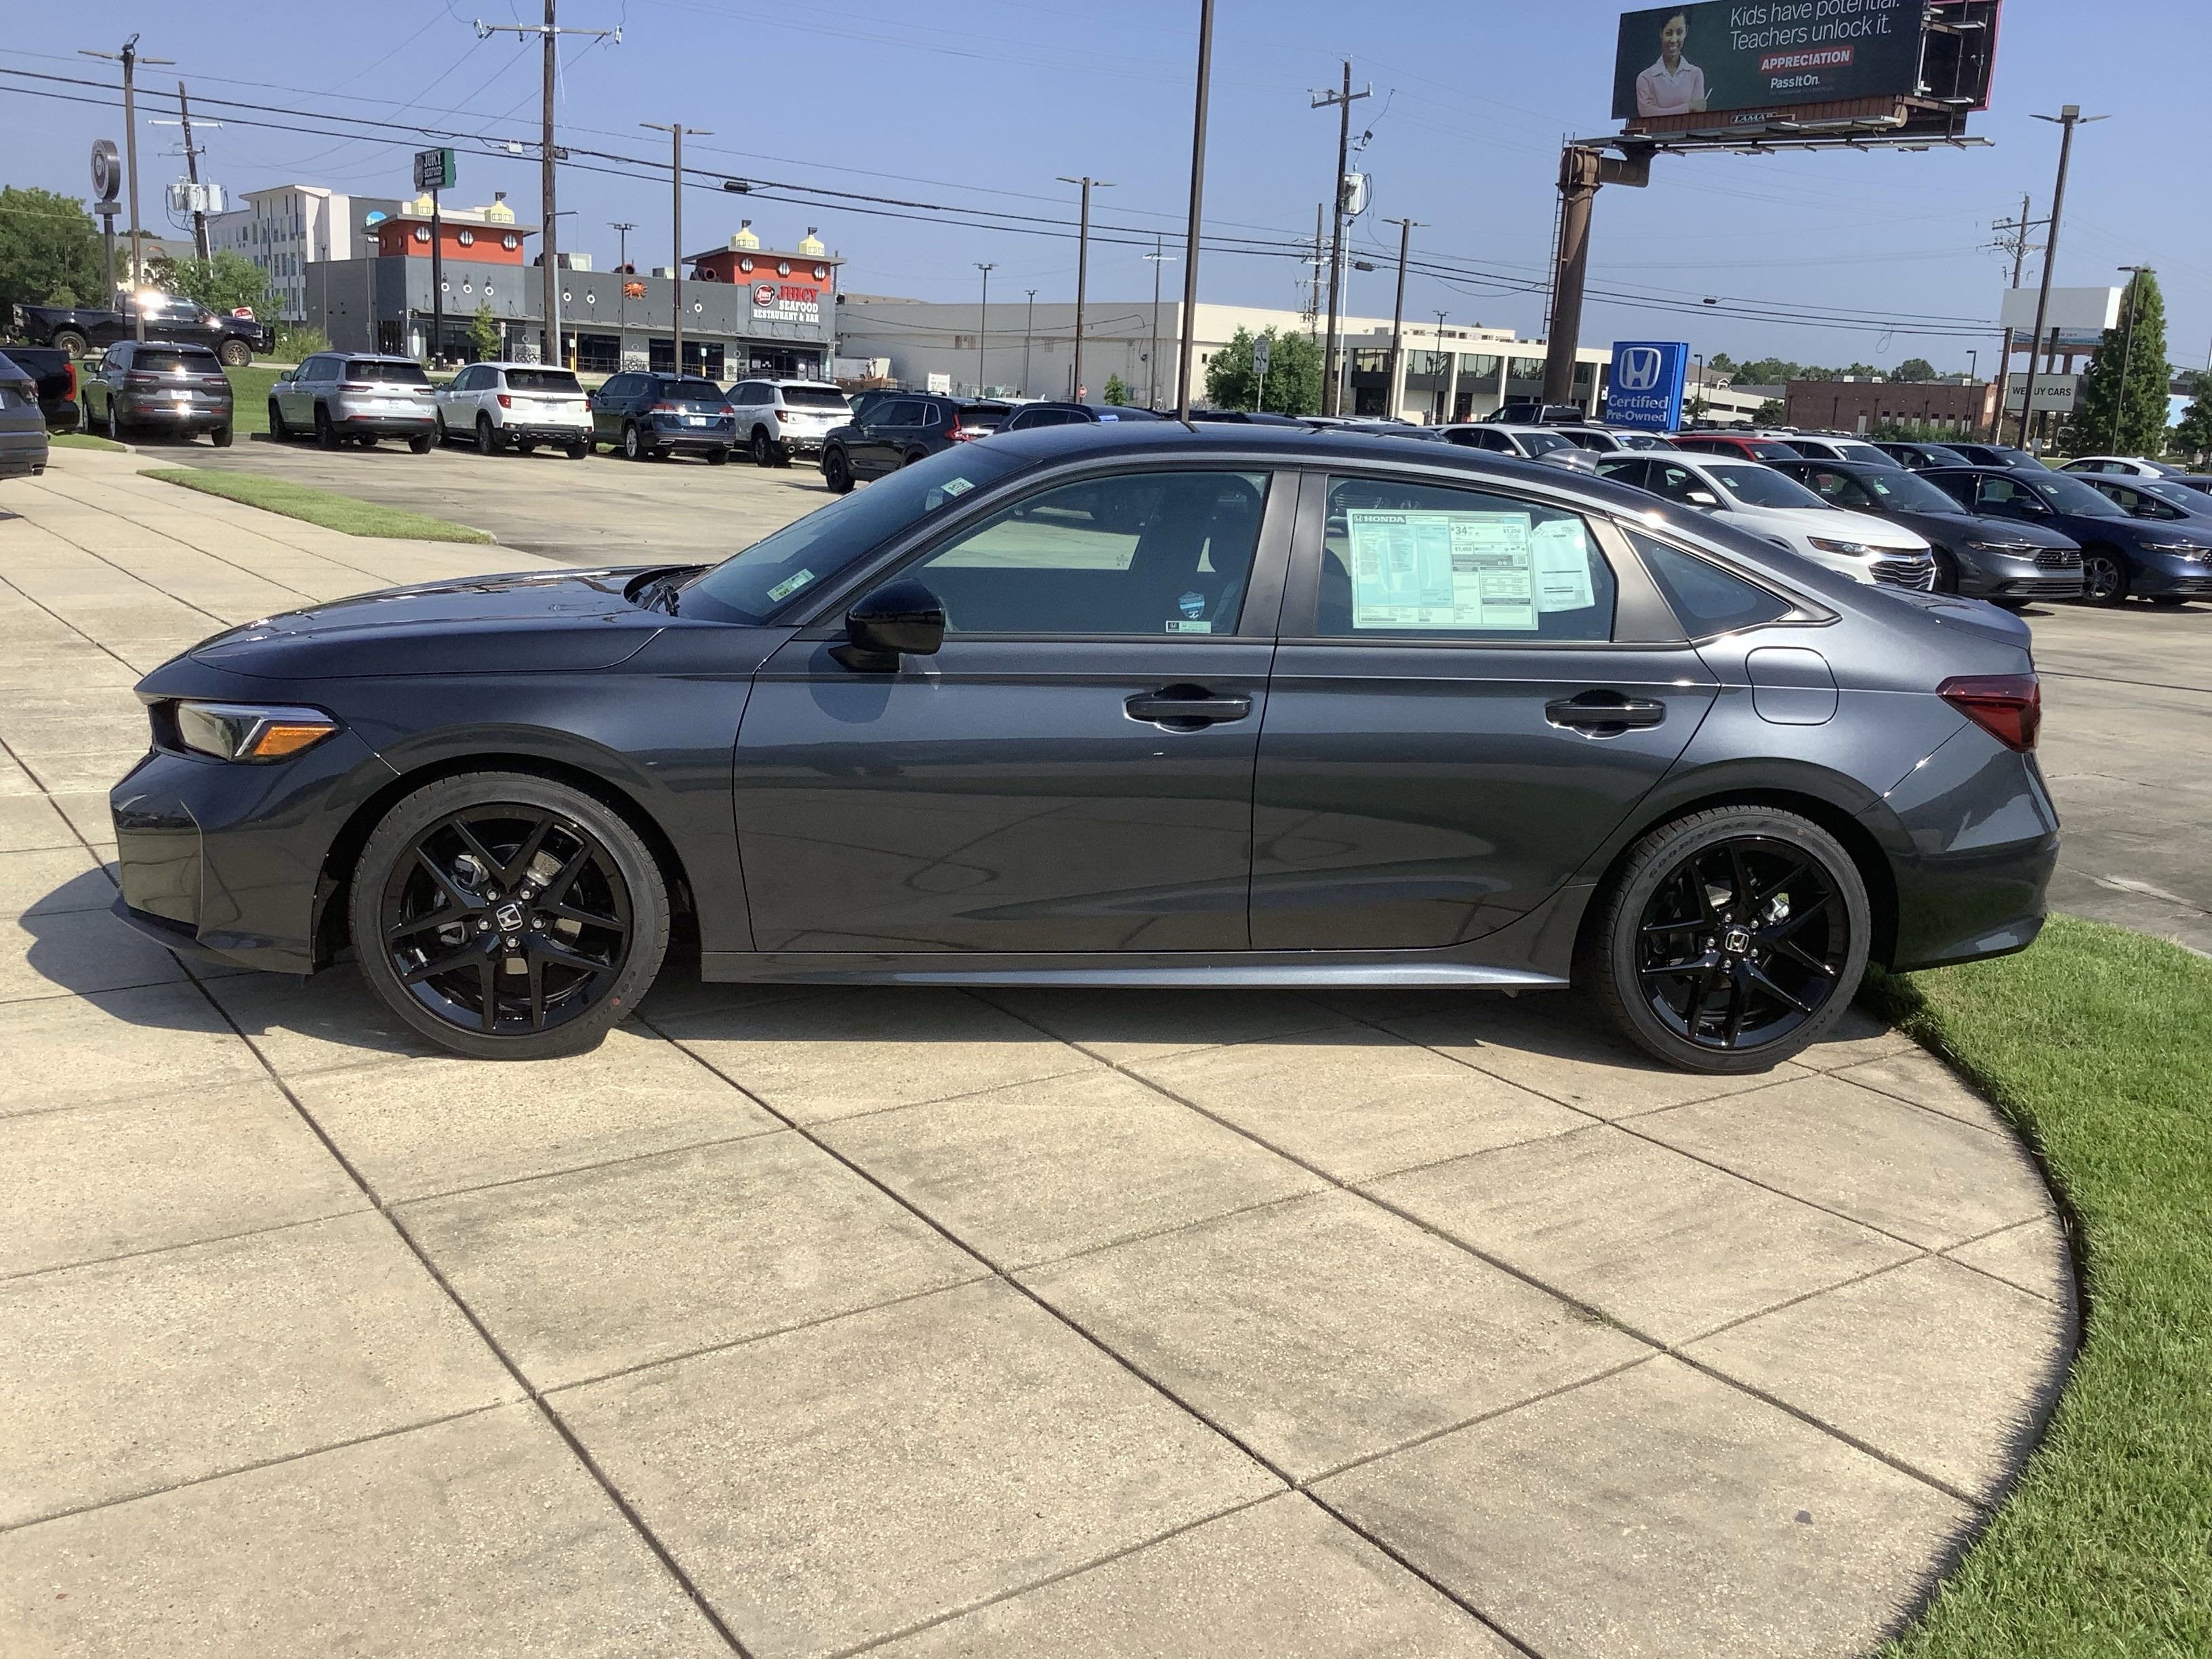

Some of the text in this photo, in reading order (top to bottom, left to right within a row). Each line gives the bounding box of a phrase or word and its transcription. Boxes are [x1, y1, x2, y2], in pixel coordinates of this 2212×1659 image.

[1730, 5, 1767, 28] Kids
[1771, 2, 1812, 23] have
[1730, 14, 1891, 50] Teachers unlock it.
[1761, 49, 1851, 71] APPRECIATION
[424, 151, 441, 167] JUICY
[777, 285, 817, 302] JUICY
[779, 300, 819, 313] SEAFOOD
[753, 309, 819, 323] RESTAURANT & BAR
[2012, 387, 2071, 396] WE UY CARS
[1608, 394, 1668, 409] Certified
[1606, 409, 1667, 422] Pre-Owned
[1363, 515, 1406, 524] HONDA
[1455, 526, 1467, 535] 34
